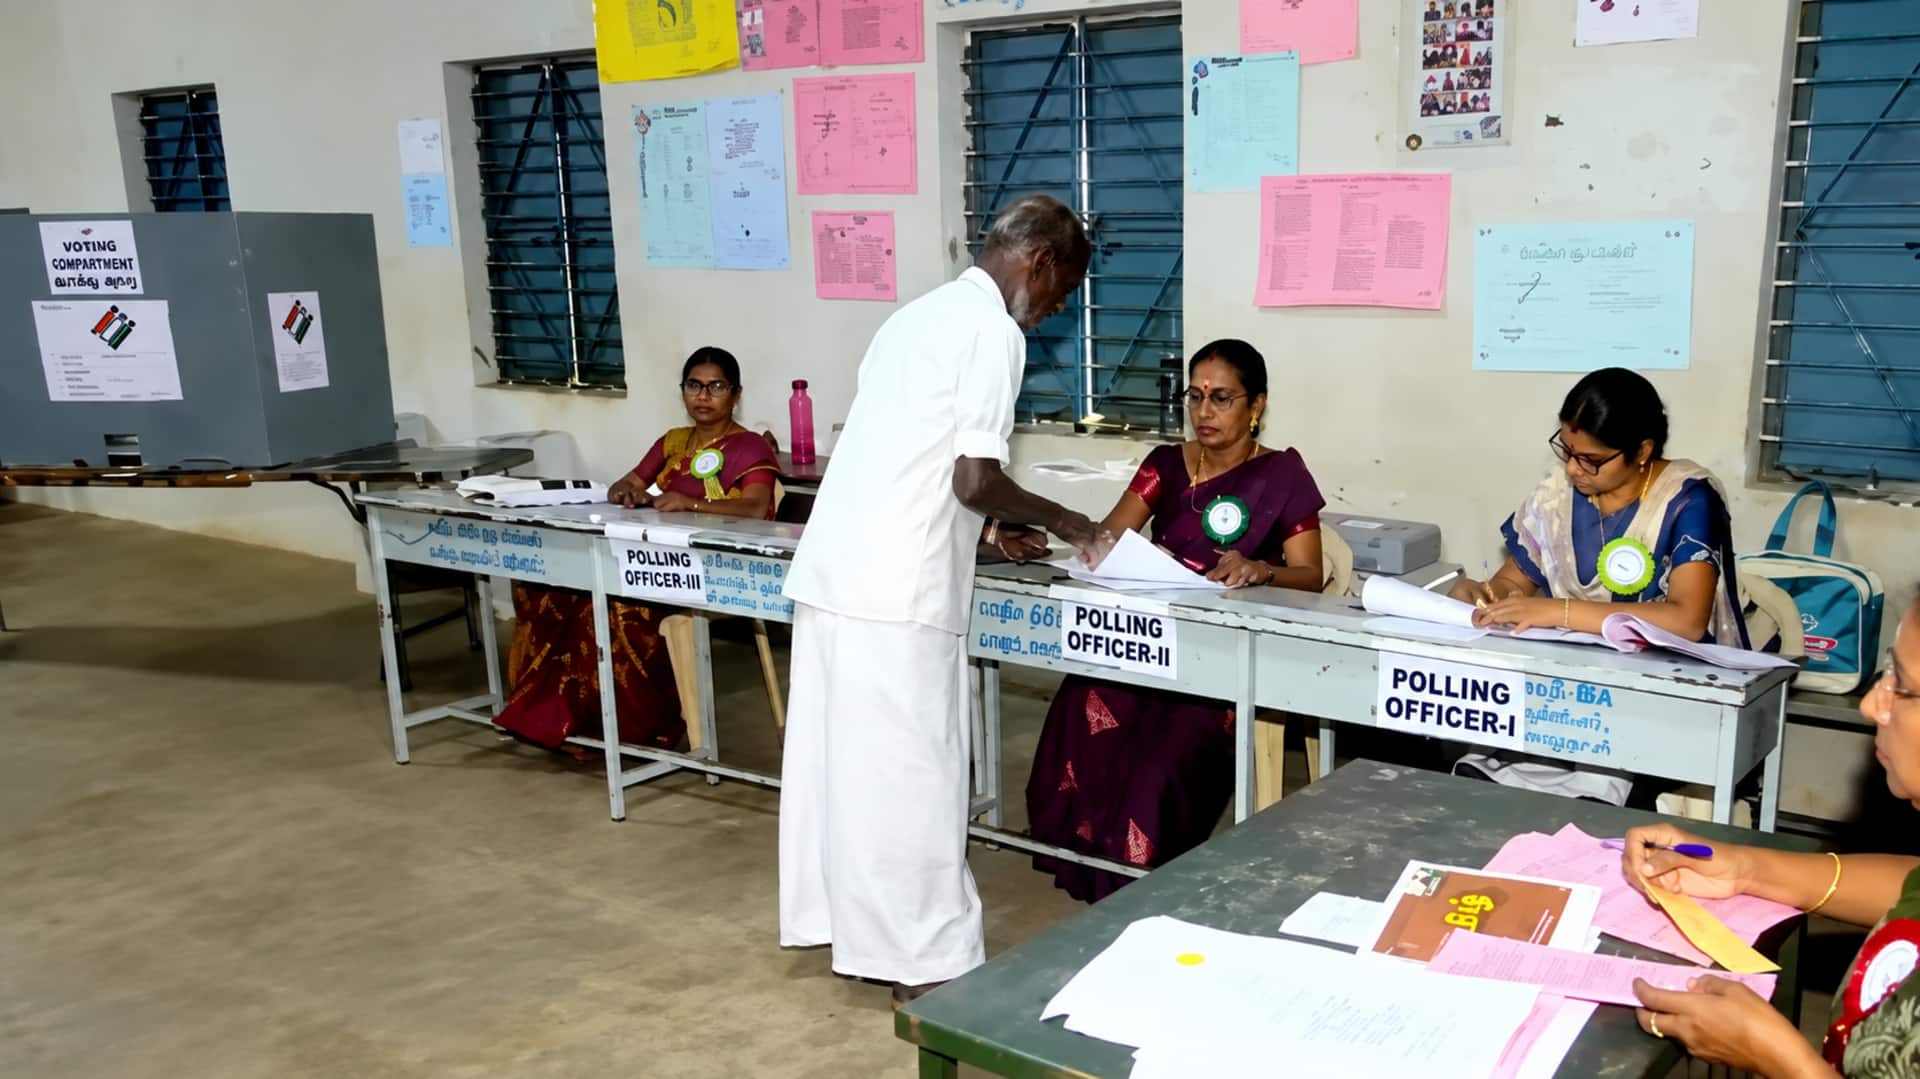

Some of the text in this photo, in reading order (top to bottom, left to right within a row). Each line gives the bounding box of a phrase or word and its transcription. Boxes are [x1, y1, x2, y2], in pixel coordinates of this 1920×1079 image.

[62, 240, 117, 253] VOTING
[52, 258, 134, 271] COMPARTMENT
[627, 549, 691, 568] POLLING
[625, 569, 701, 591] OFFICER-III
[1075, 605, 1163, 639] POLLING
[1067, 630, 1170, 667] OFFICER-II
[1392, 667, 1511, 705] POLLING
[1385, 696, 1516, 737] OFFICER-I
